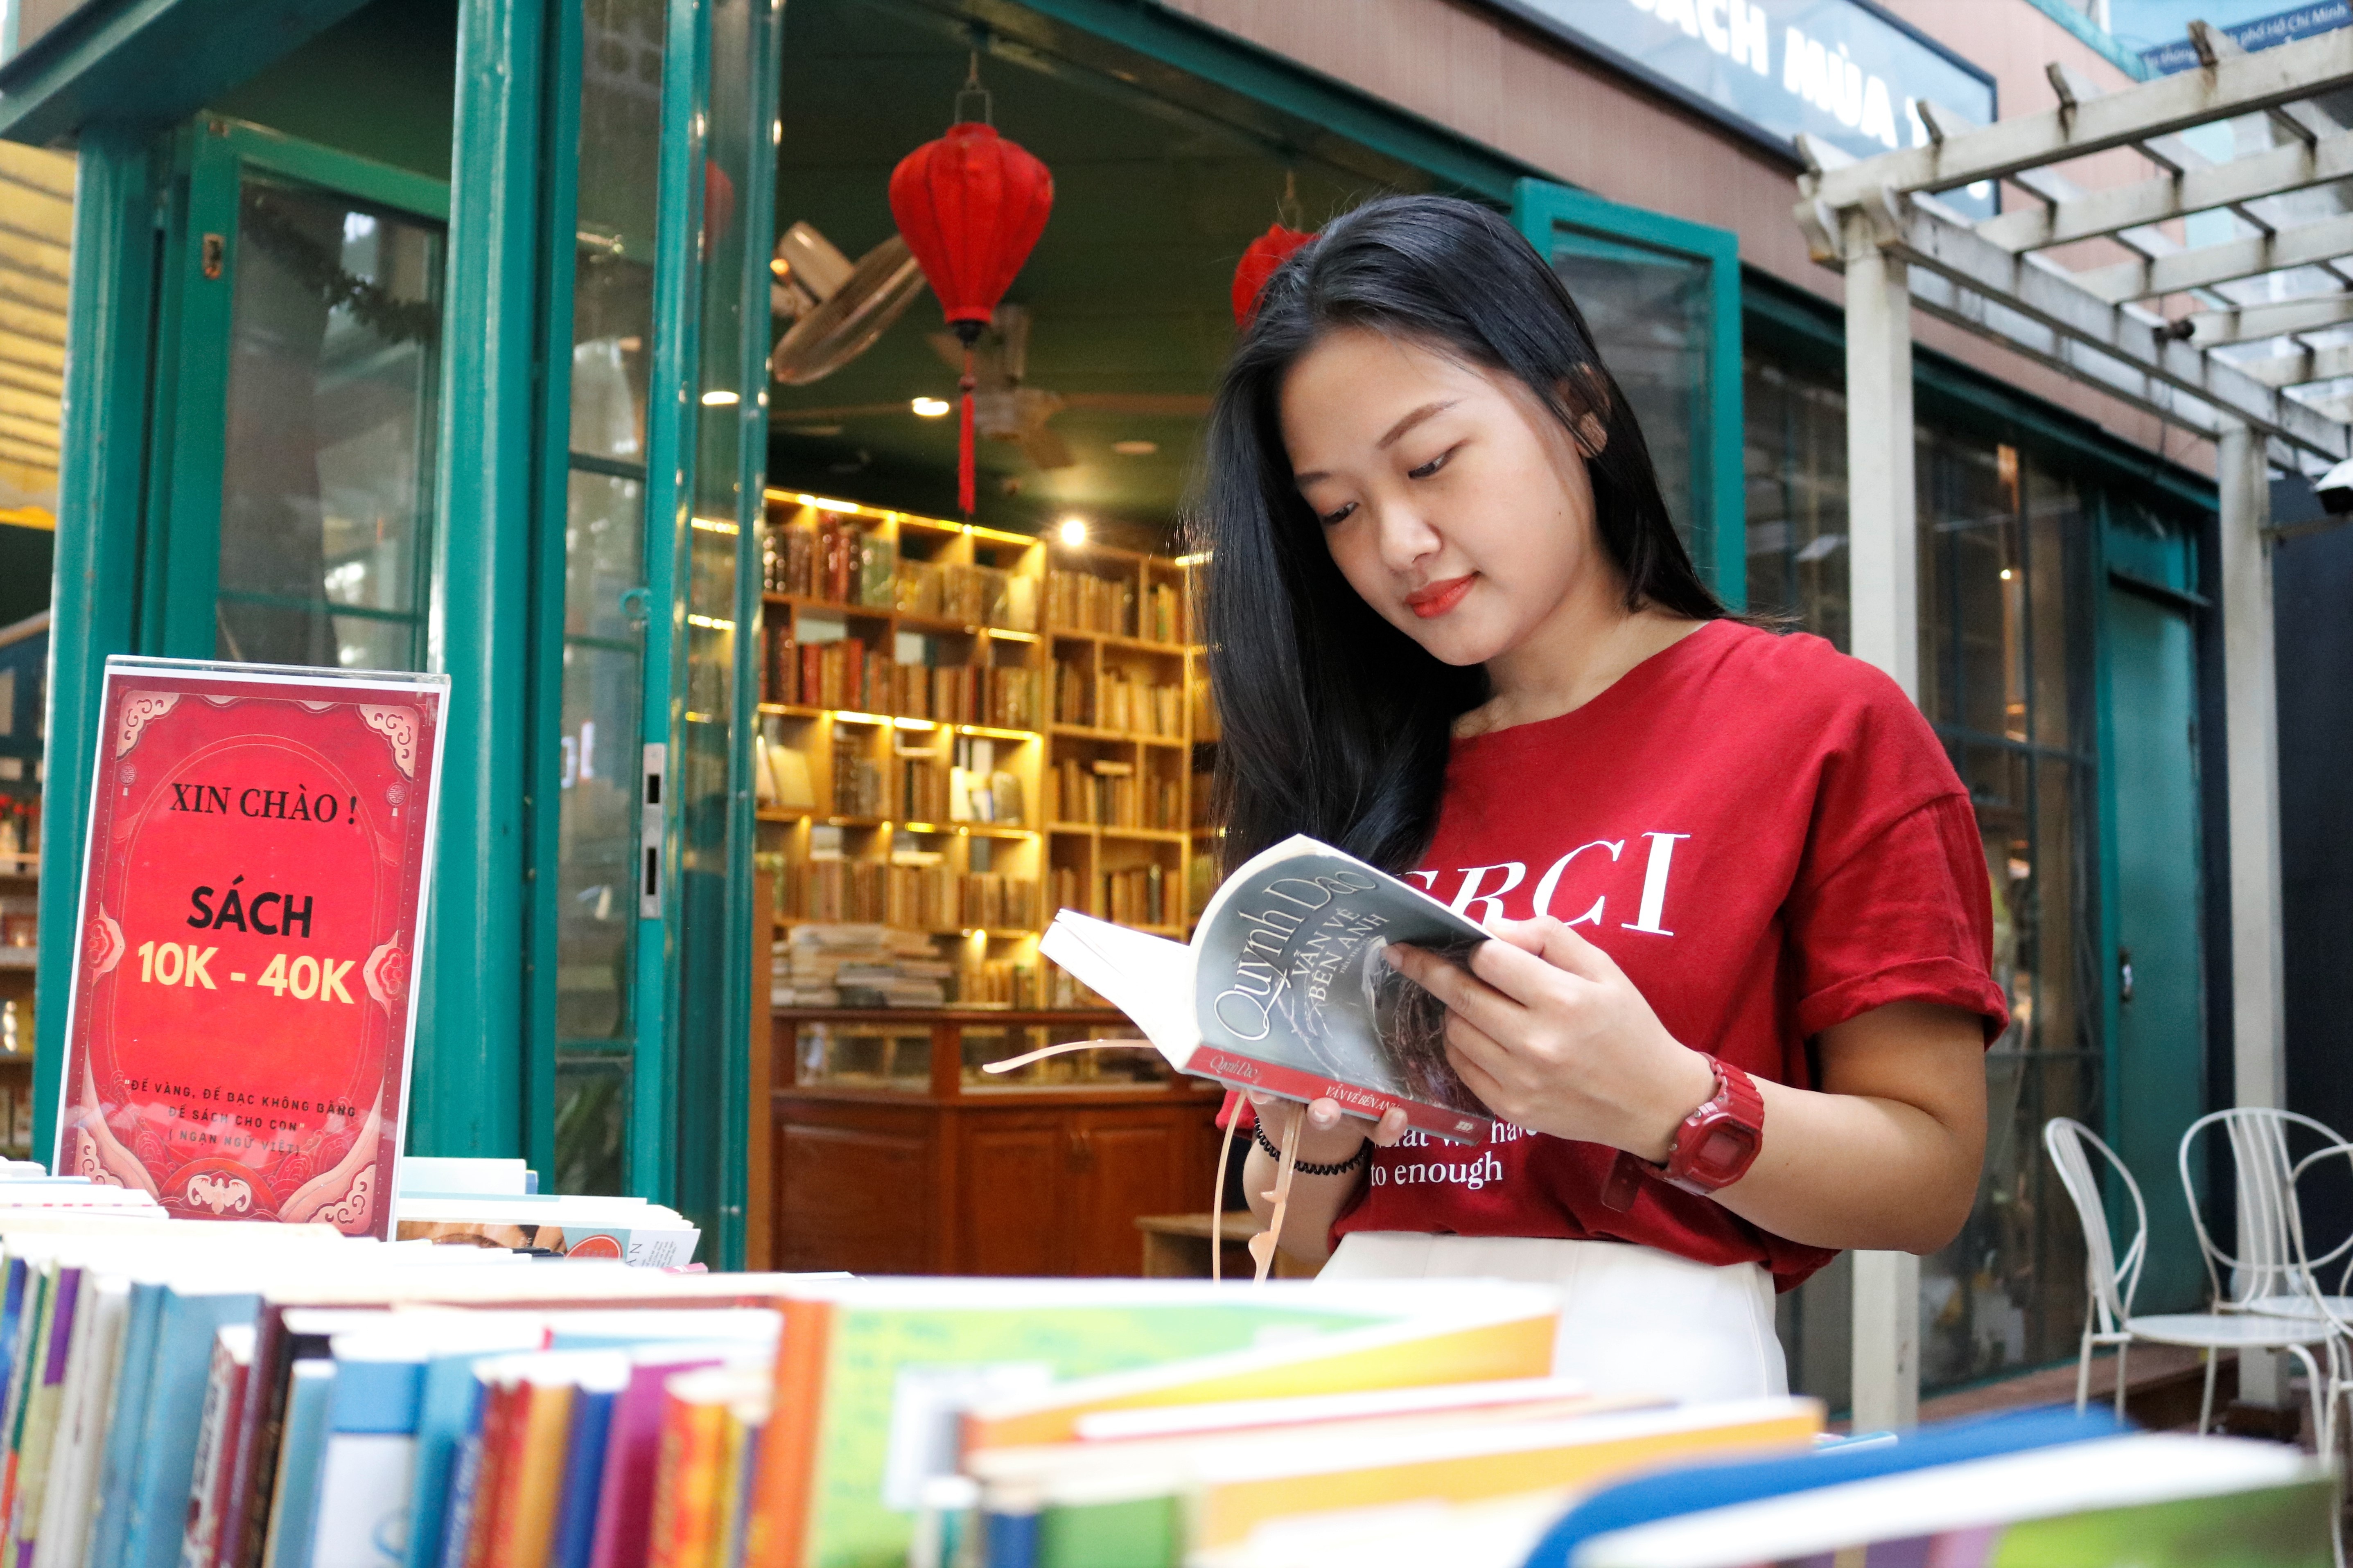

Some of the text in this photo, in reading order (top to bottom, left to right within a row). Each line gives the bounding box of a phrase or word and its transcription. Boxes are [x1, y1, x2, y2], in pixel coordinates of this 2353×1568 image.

[2312, 2, 2347, 23] Minh
[1782, 26, 1899, 149] MÙA
[169, 783, 232, 815] XIN
[239, 784, 338, 823] CHÀO
[186, 874, 314, 939] SÁCH
[1262, 871, 1377, 911] Dao
[138, 941, 219, 990] 10K
[257, 954, 356, 1005] 40K
[1308, 913, 1390, 1002] BÊN ANH
[155, 1082, 195, 1099] VÀNG,
[227, 1092, 255, 1107] BẠC
[262, 1096, 309, 1112] KHÔNG
[1346, 1088, 1362, 1103] VỀ
[1357, 1094, 1380, 1108] BÊN
[192, 1108, 228, 1124] SÁCH
[235, 1115, 262, 1128] CHO
[1371, 1151, 1503, 1190] to enough
